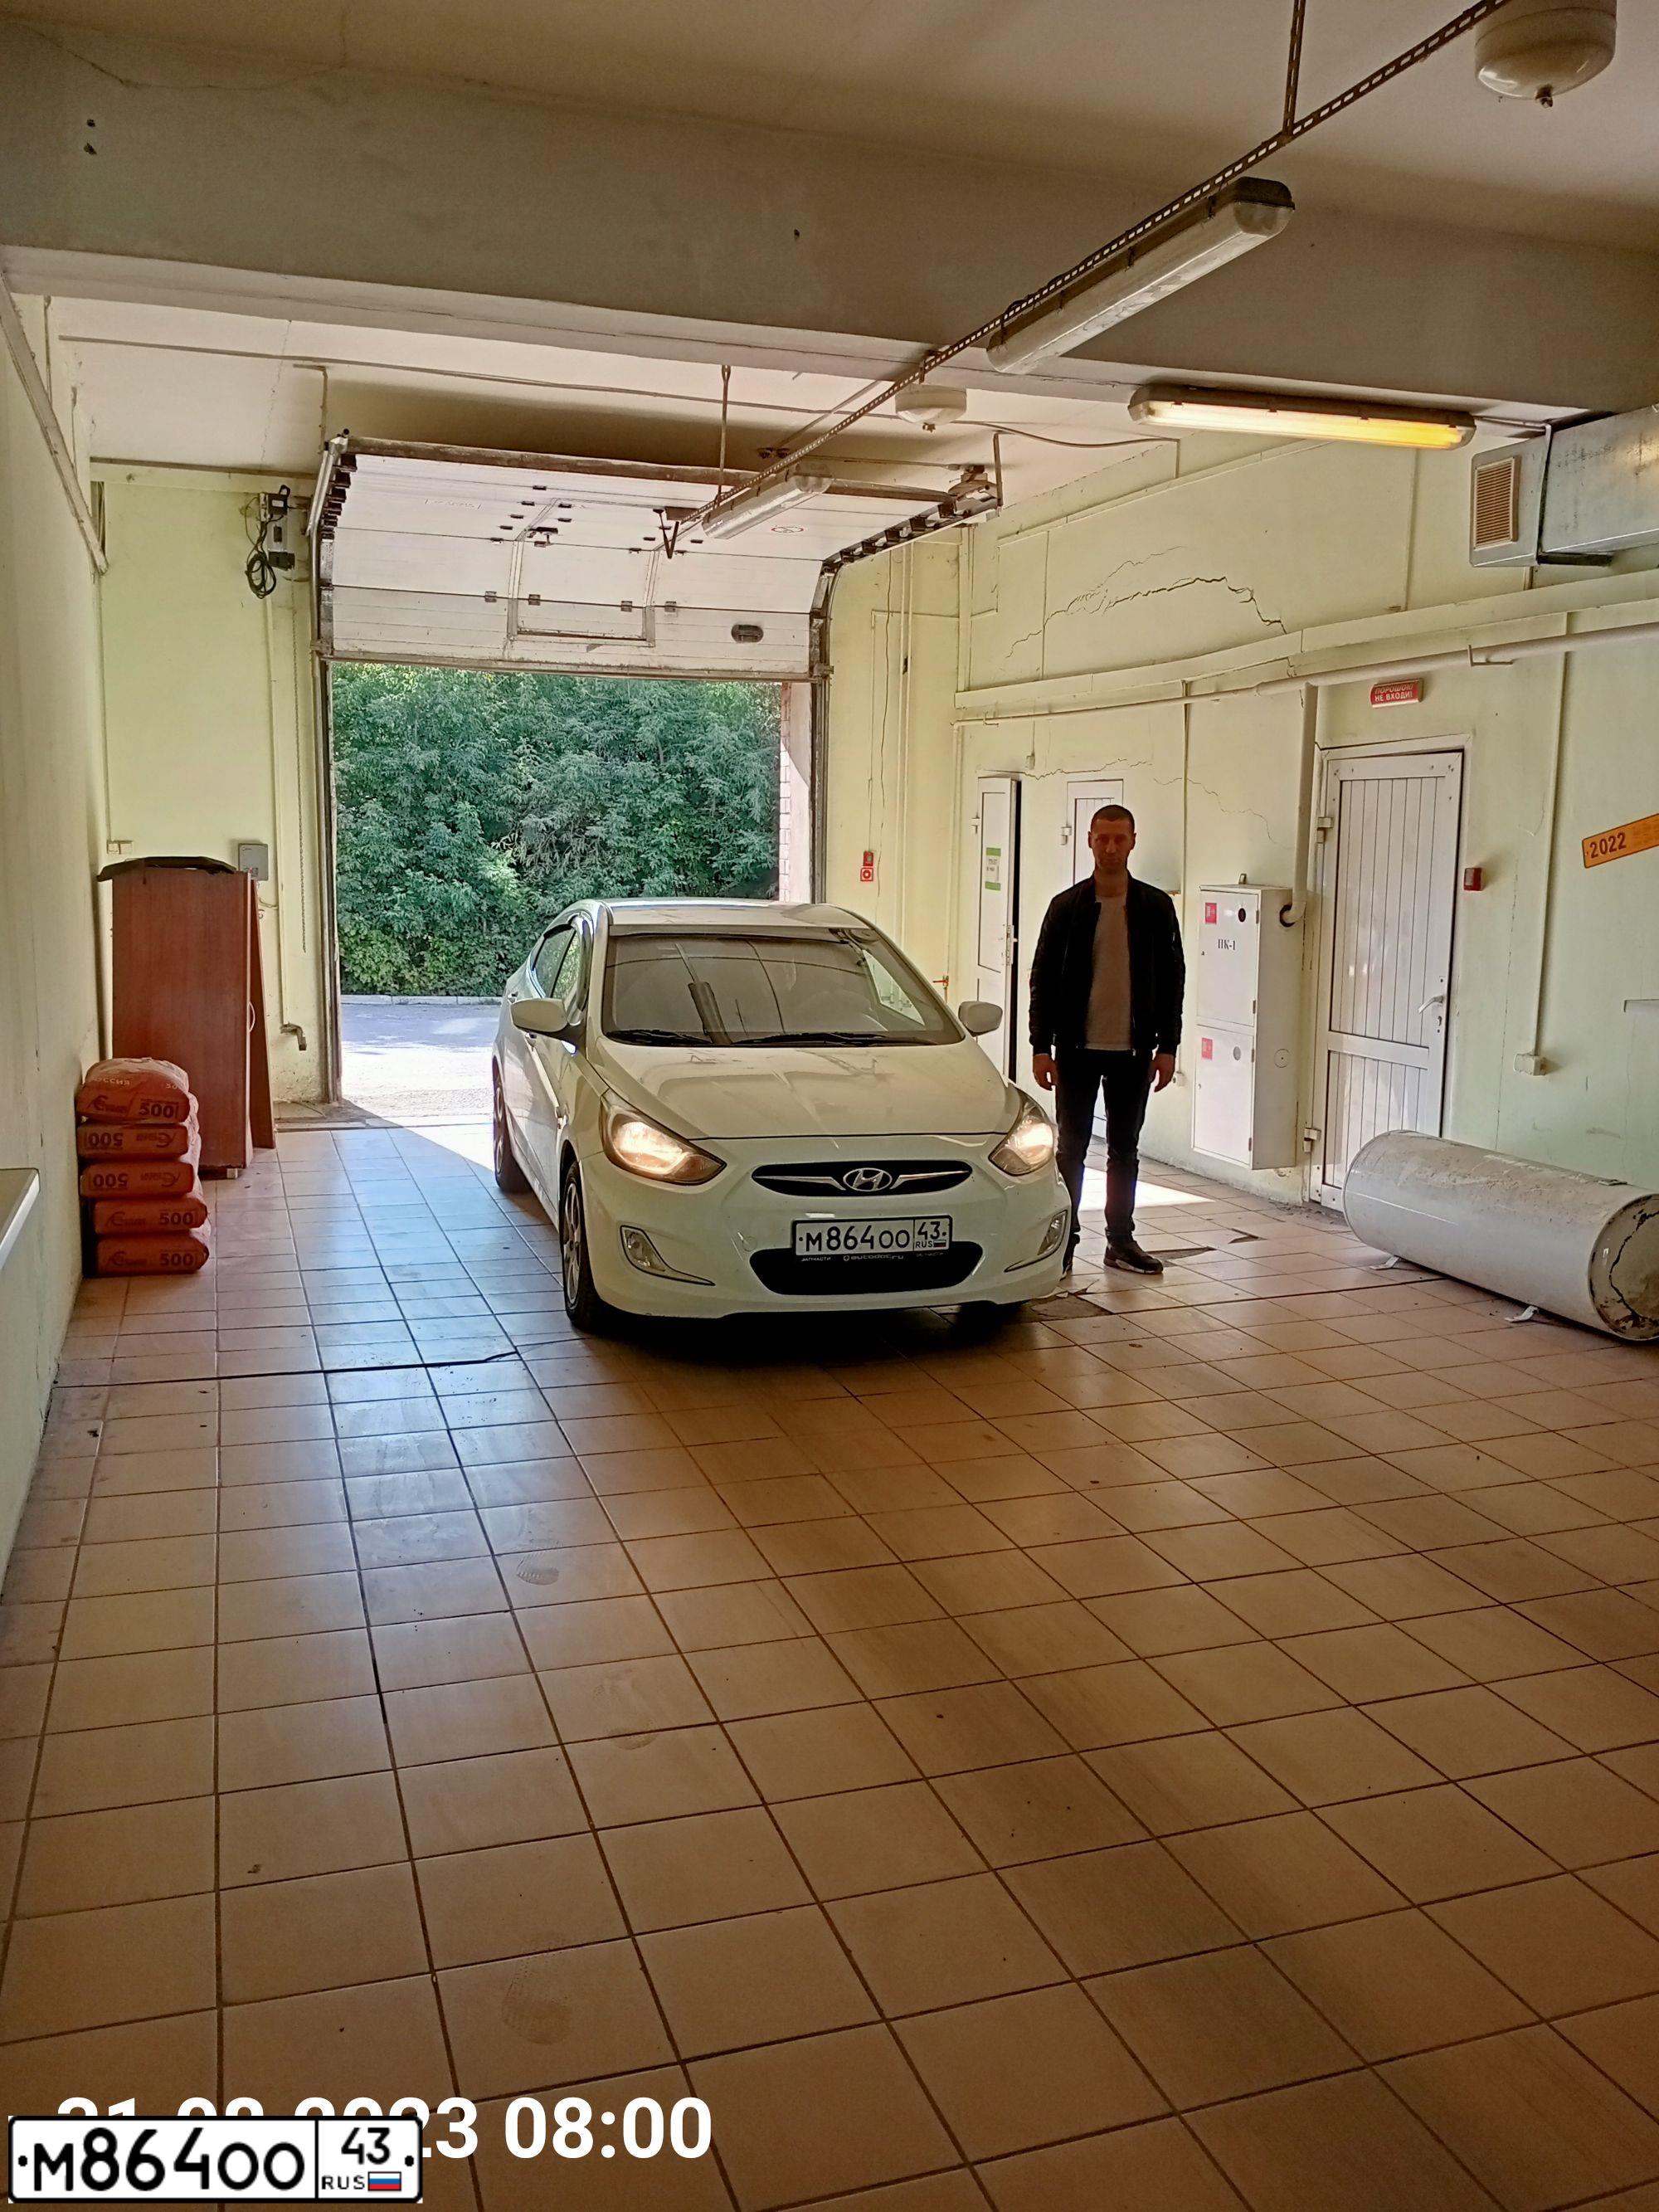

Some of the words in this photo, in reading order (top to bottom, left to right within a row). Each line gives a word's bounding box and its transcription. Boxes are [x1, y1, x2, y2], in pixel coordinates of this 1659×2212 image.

[1374, 694, 1384, 702] НЕ
[1385, 690, 1413, 701] ВХОДИ!
[1589, 831, 1627, 859] 2022
[1218, 938, 1236, 951] ПК-1
[139, 1103, 174, 1118] 500
[88, 1133, 124, 1147] 500
[93, 1173, 128, 1188] 500
[159, 1212, 194, 1225] 500
[917, 1221, 941, 1240] 43
[916, 1240, 932, 1249] RUS
[159, 1253, 194, 1267] 500
